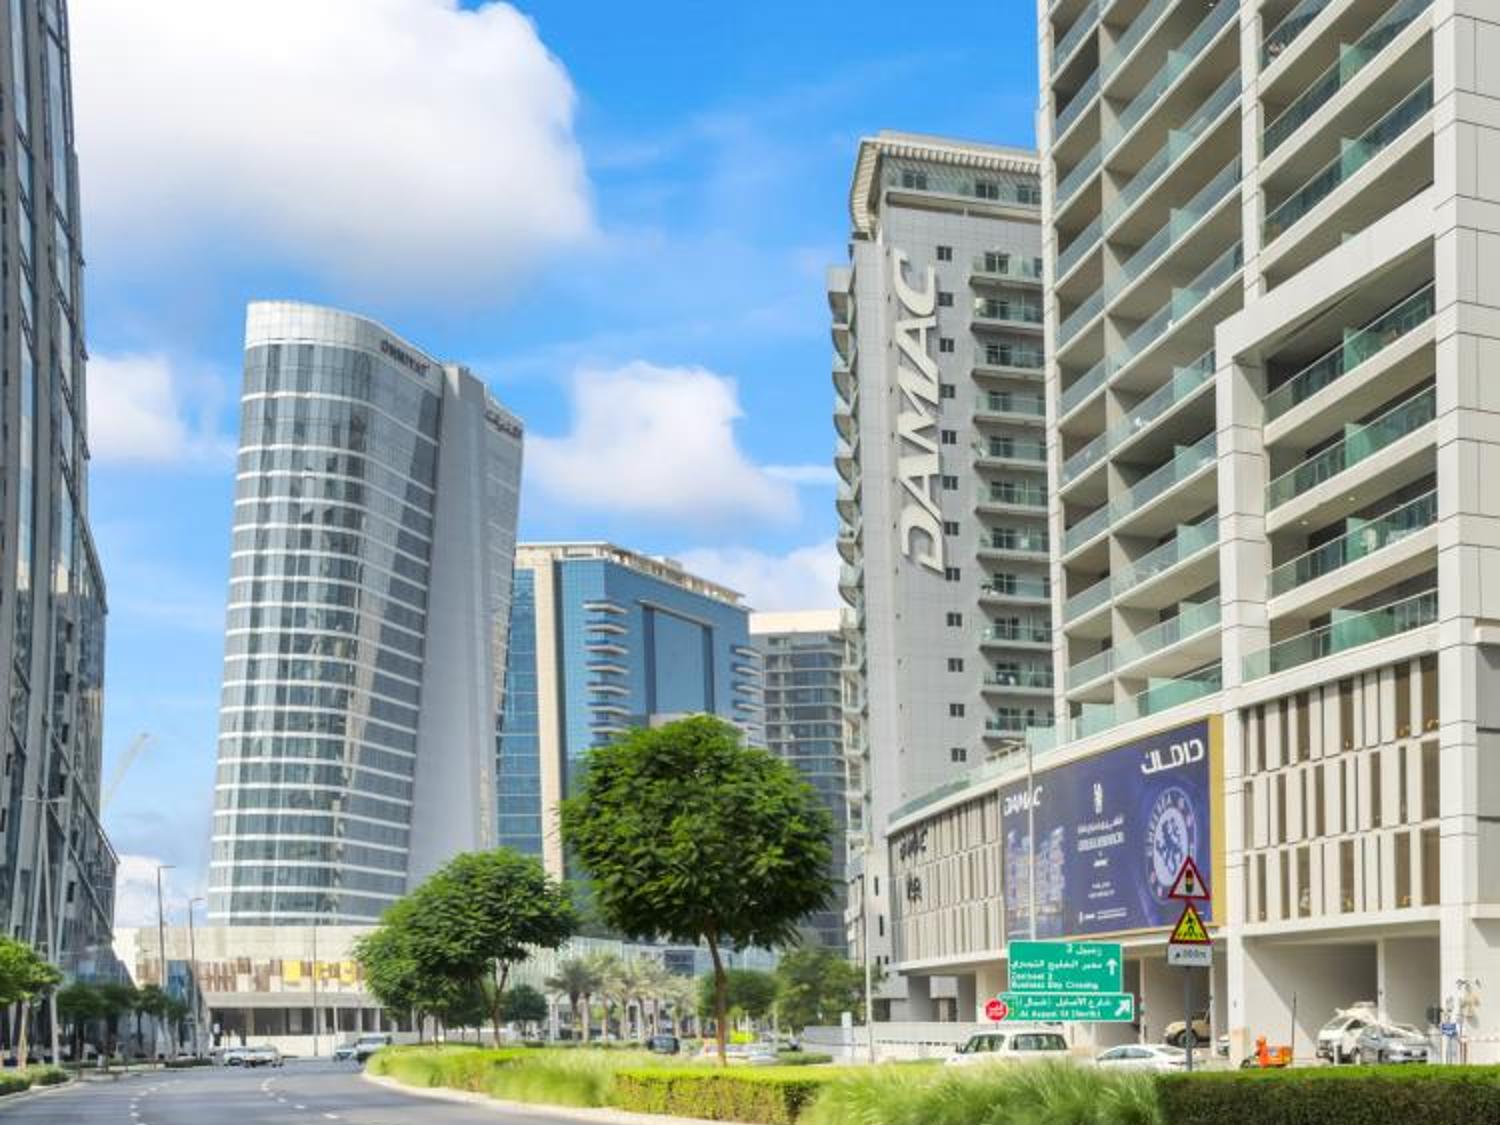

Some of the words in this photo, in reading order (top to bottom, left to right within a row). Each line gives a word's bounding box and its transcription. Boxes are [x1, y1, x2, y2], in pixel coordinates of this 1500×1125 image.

[893, 247, 945, 574] DAMAC
[1011, 981, 1045, 990] Business
[1047, 981, 1063, 990] Bay
[1065, 981, 1099, 990] Crossing
